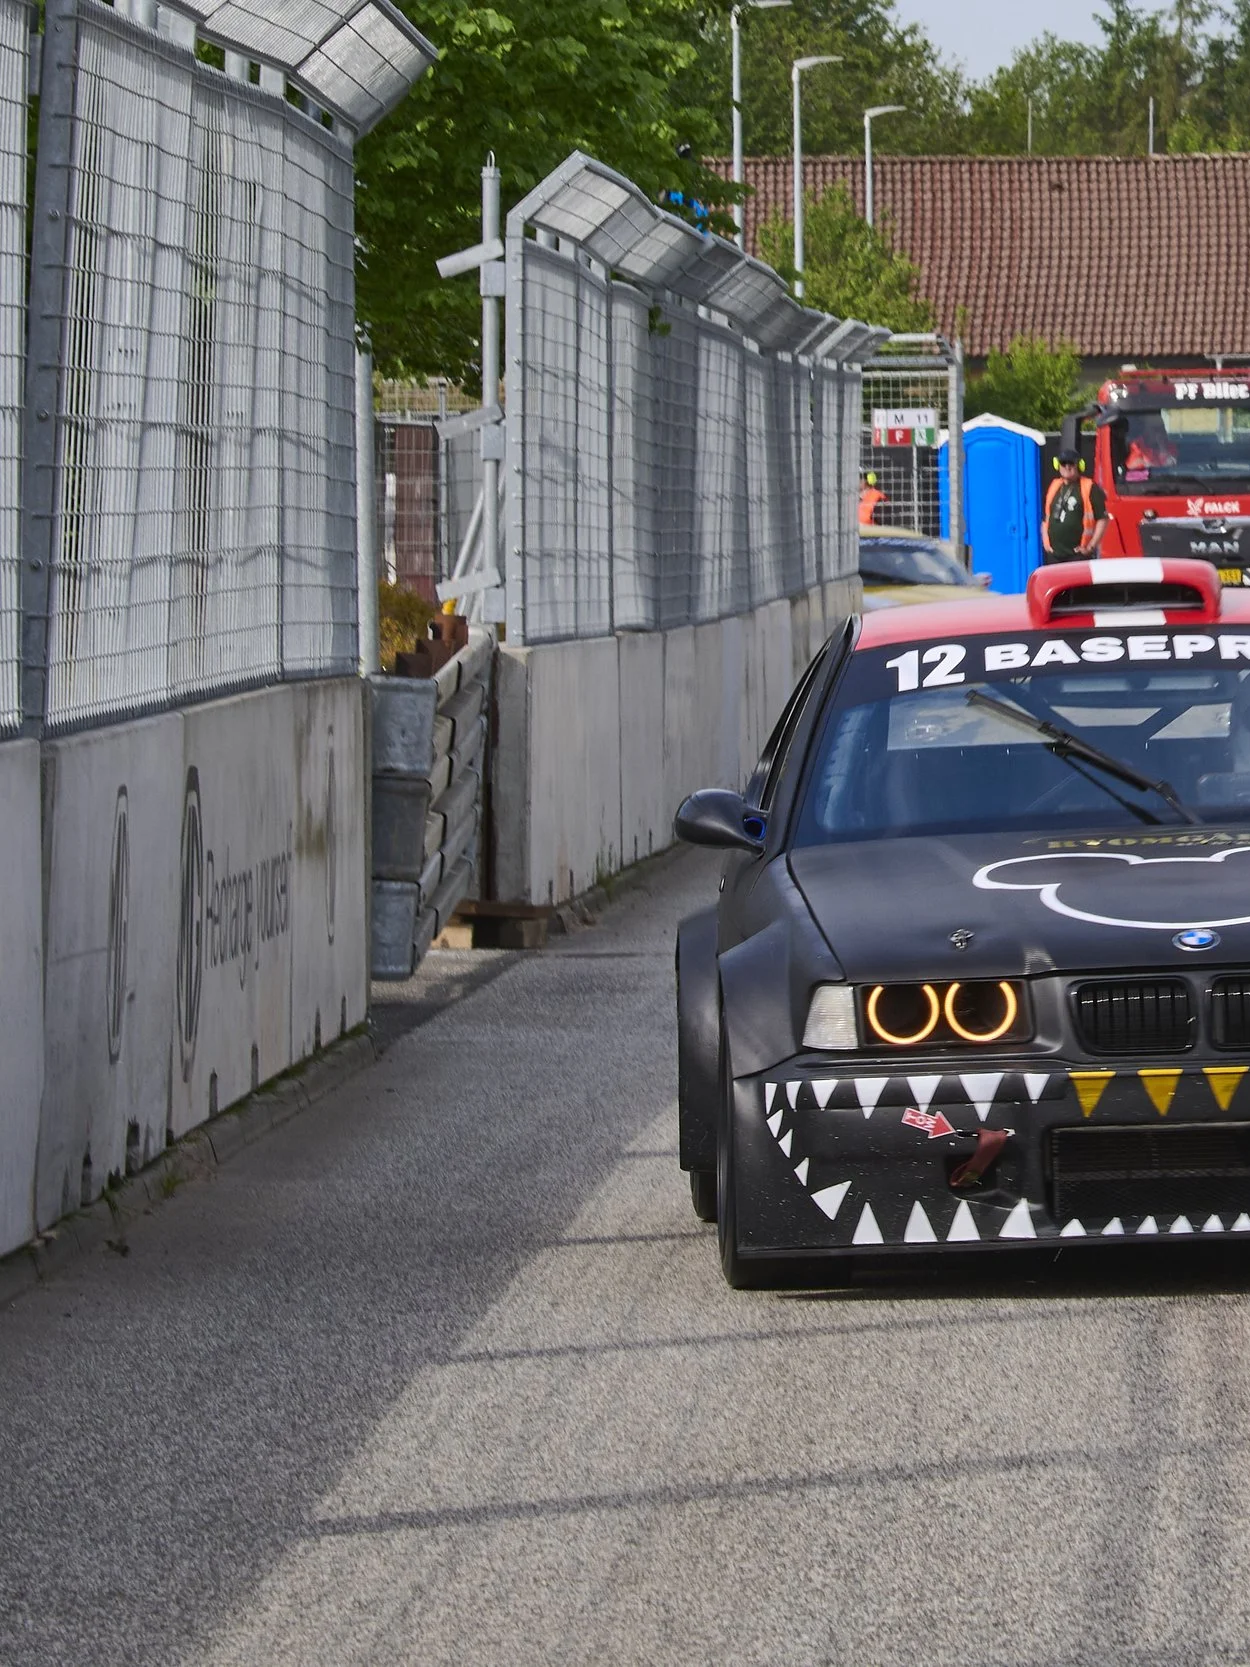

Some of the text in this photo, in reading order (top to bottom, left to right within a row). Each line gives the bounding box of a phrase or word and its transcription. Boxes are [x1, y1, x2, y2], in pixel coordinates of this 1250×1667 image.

[1174, 383, 1198, 400] PF
[1204, 501, 1240, 514] FALCK
[1190, 541, 1240, 553] MAN
[886, 643, 967, 692] 12
[205, 845, 252, 991] Recharge
[904, 1111, 937, 1129] TOW
